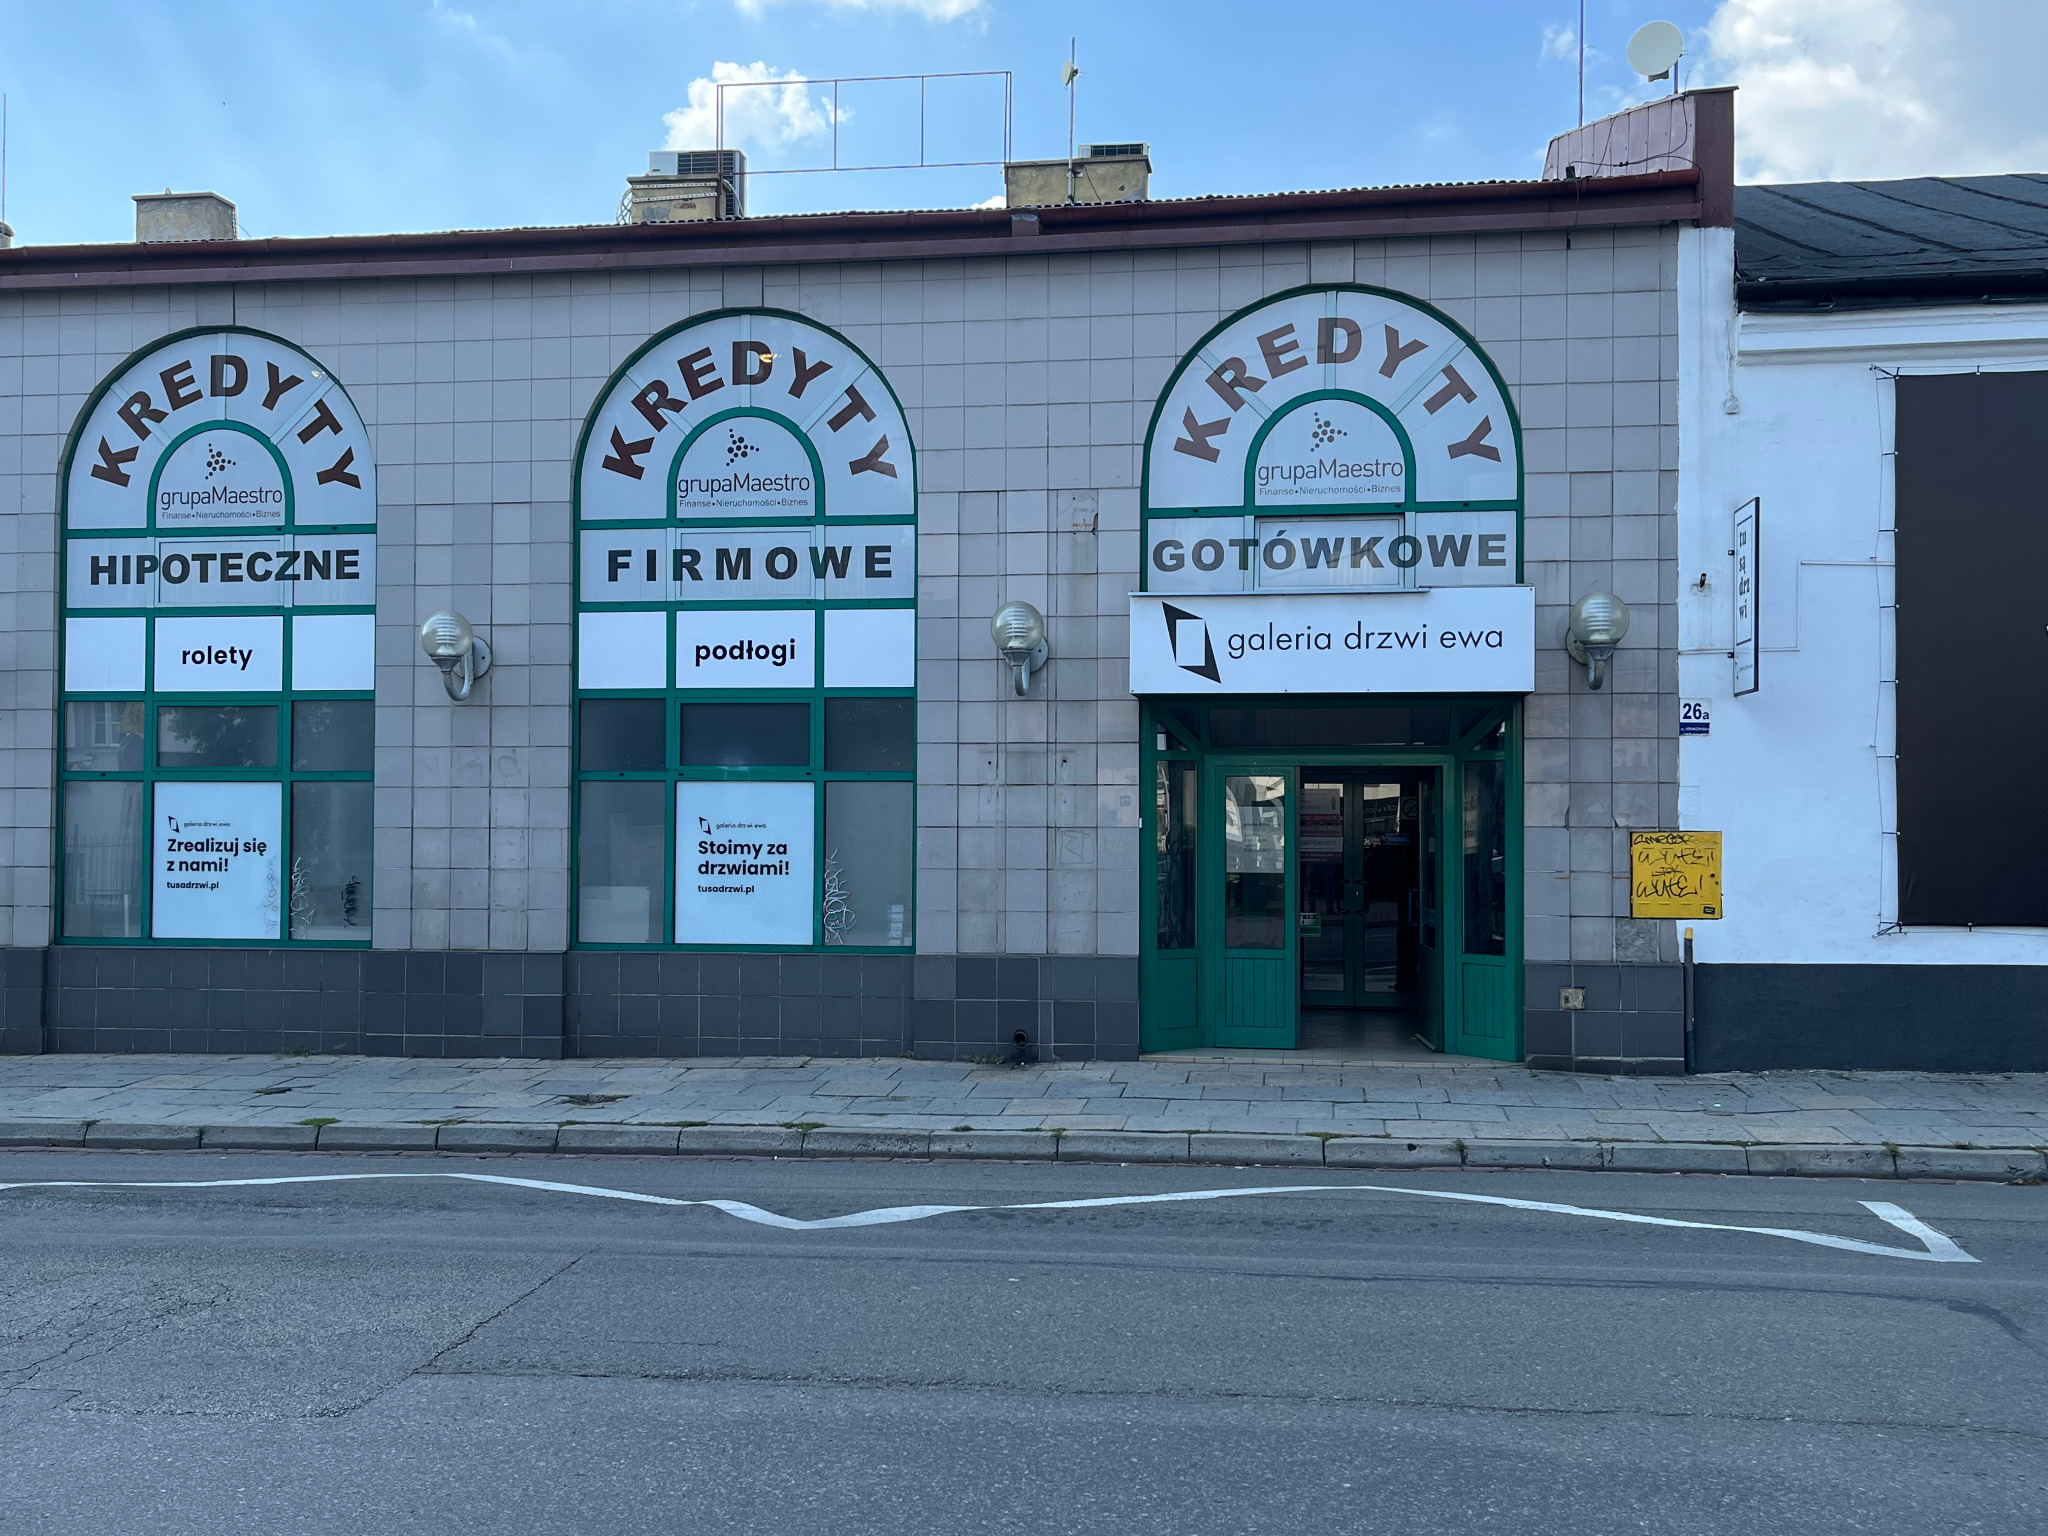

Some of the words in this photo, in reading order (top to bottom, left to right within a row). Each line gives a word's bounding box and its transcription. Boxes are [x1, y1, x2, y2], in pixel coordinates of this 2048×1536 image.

[1174, 317, 1502, 464] KREDYTY
[91, 354, 362, 490] KREDYTY
[602, 341, 898, 480] KREDYTY
[1258, 458, 1404, 486] grupaMaestro
[160, 486, 283, 510] grupaMaestro
[678, 473, 811, 498] grupaMaestro
[607, 545, 893, 582] FIRMOWE
[1152, 529, 1507, 572] GOTÓWKOWE
[90, 549, 360, 585] HIPOTECZNE
[695, 638, 796, 668] podłogi
[1227, 621, 1331, 661] galeria
[1343, 621, 1428, 650] drzwi
[1439, 629, 1504, 649] ewa
[181, 645, 253, 671] rolety
[1682, 702, 1710, 720] 26a
[167, 837, 239, 857] Zrealizuj
[243, 837, 267, 856] się
[698, 839, 763, 860] Stoimy
[767, 843, 787, 855] za
[166, 860, 175, 872] z
[178, 857, 229, 872] nami!
[697, 859, 790, 876] drzwiami!
[166, 881, 220, 891] tusadrzwi.pl
[697, 884, 755, 896] tusadrzwi.pl
